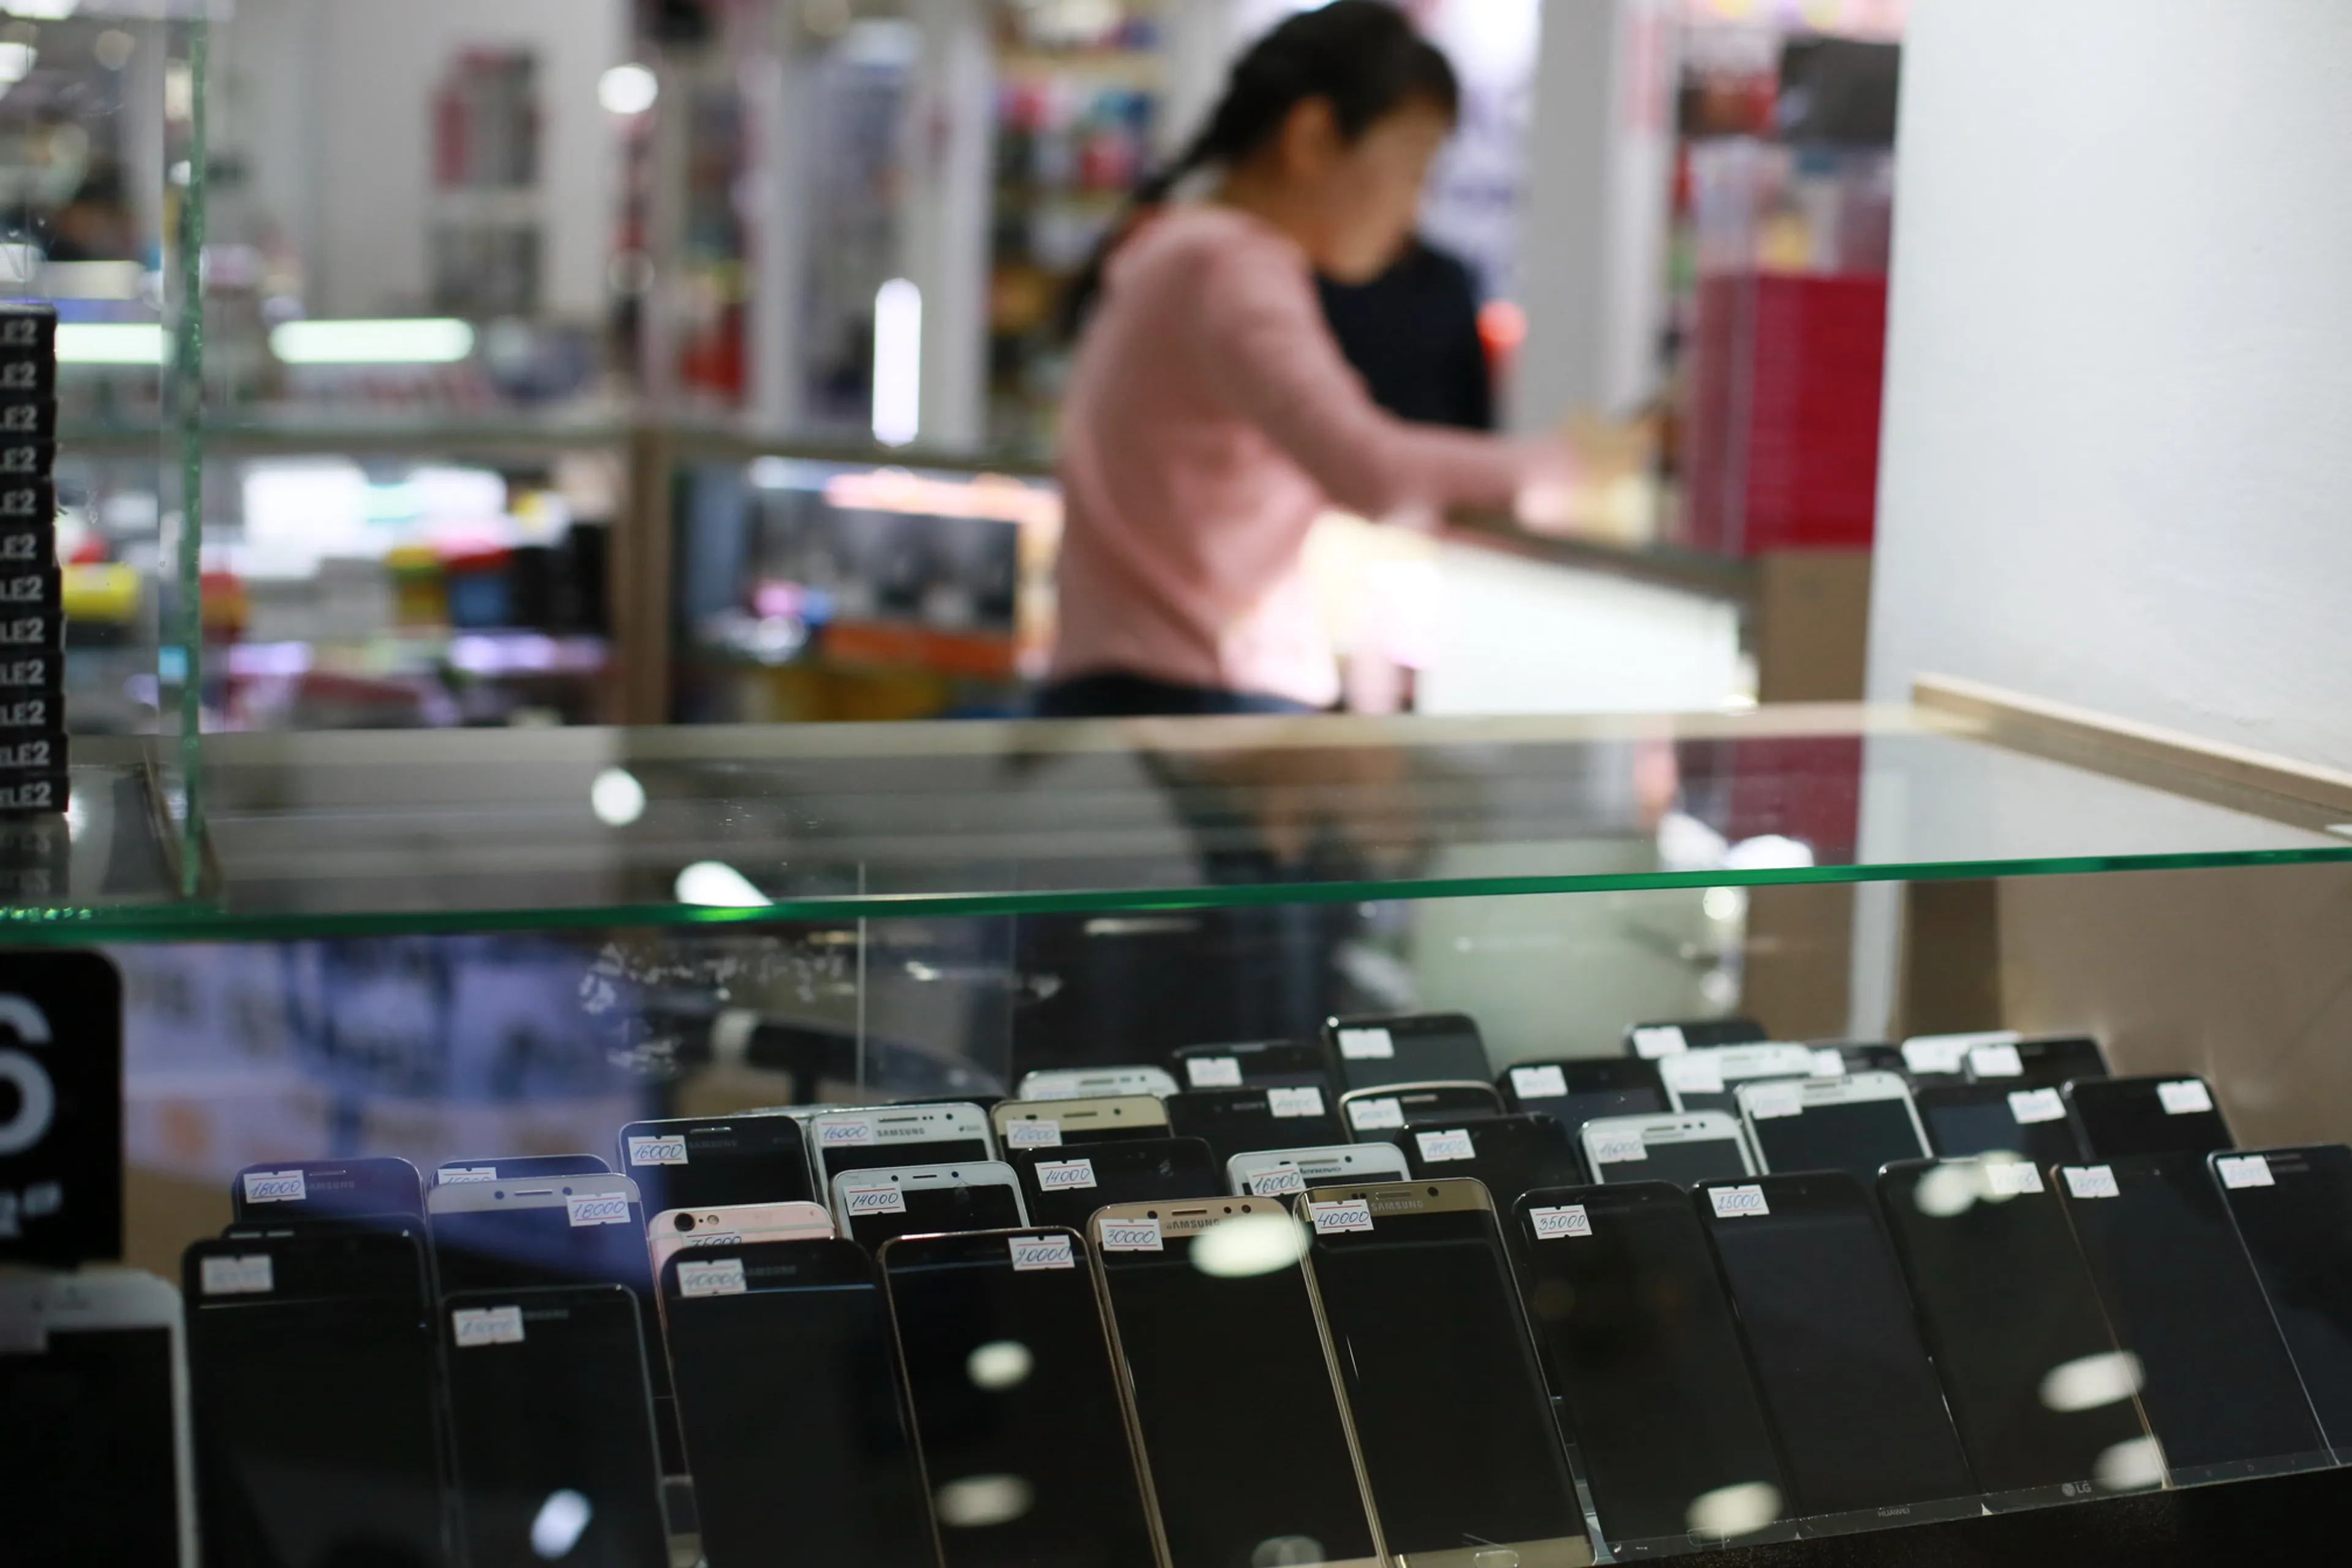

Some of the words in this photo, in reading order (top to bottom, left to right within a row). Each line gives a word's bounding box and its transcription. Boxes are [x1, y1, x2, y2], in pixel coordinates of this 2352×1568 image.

[823, 1125, 868, 1140] 16000
[876, 1127, 925, 1137] SAMSUNG
[633, 1144, 683, 1159] 16000
[1045, 1167, 1090, 1183] 14000
[251, 1180, 301, 1197] 18000
[1254, 1172, 1300, 1194] 16000
[852, 1193, 899, 1208] 14000
[1370, 1200, 1423, 1212] SAMSUNG
[573, 1201, 625, 1219] 18000
[1317, 1210, 1369, 1226] 40000
[1539, 1214, 1586, 1231] 35000
[1106, 1229, 1155, 1245] 30000
[2075, 1483, 2092, 1494] LG
[1877, 1507, 1910, 1518] HUAWEI
